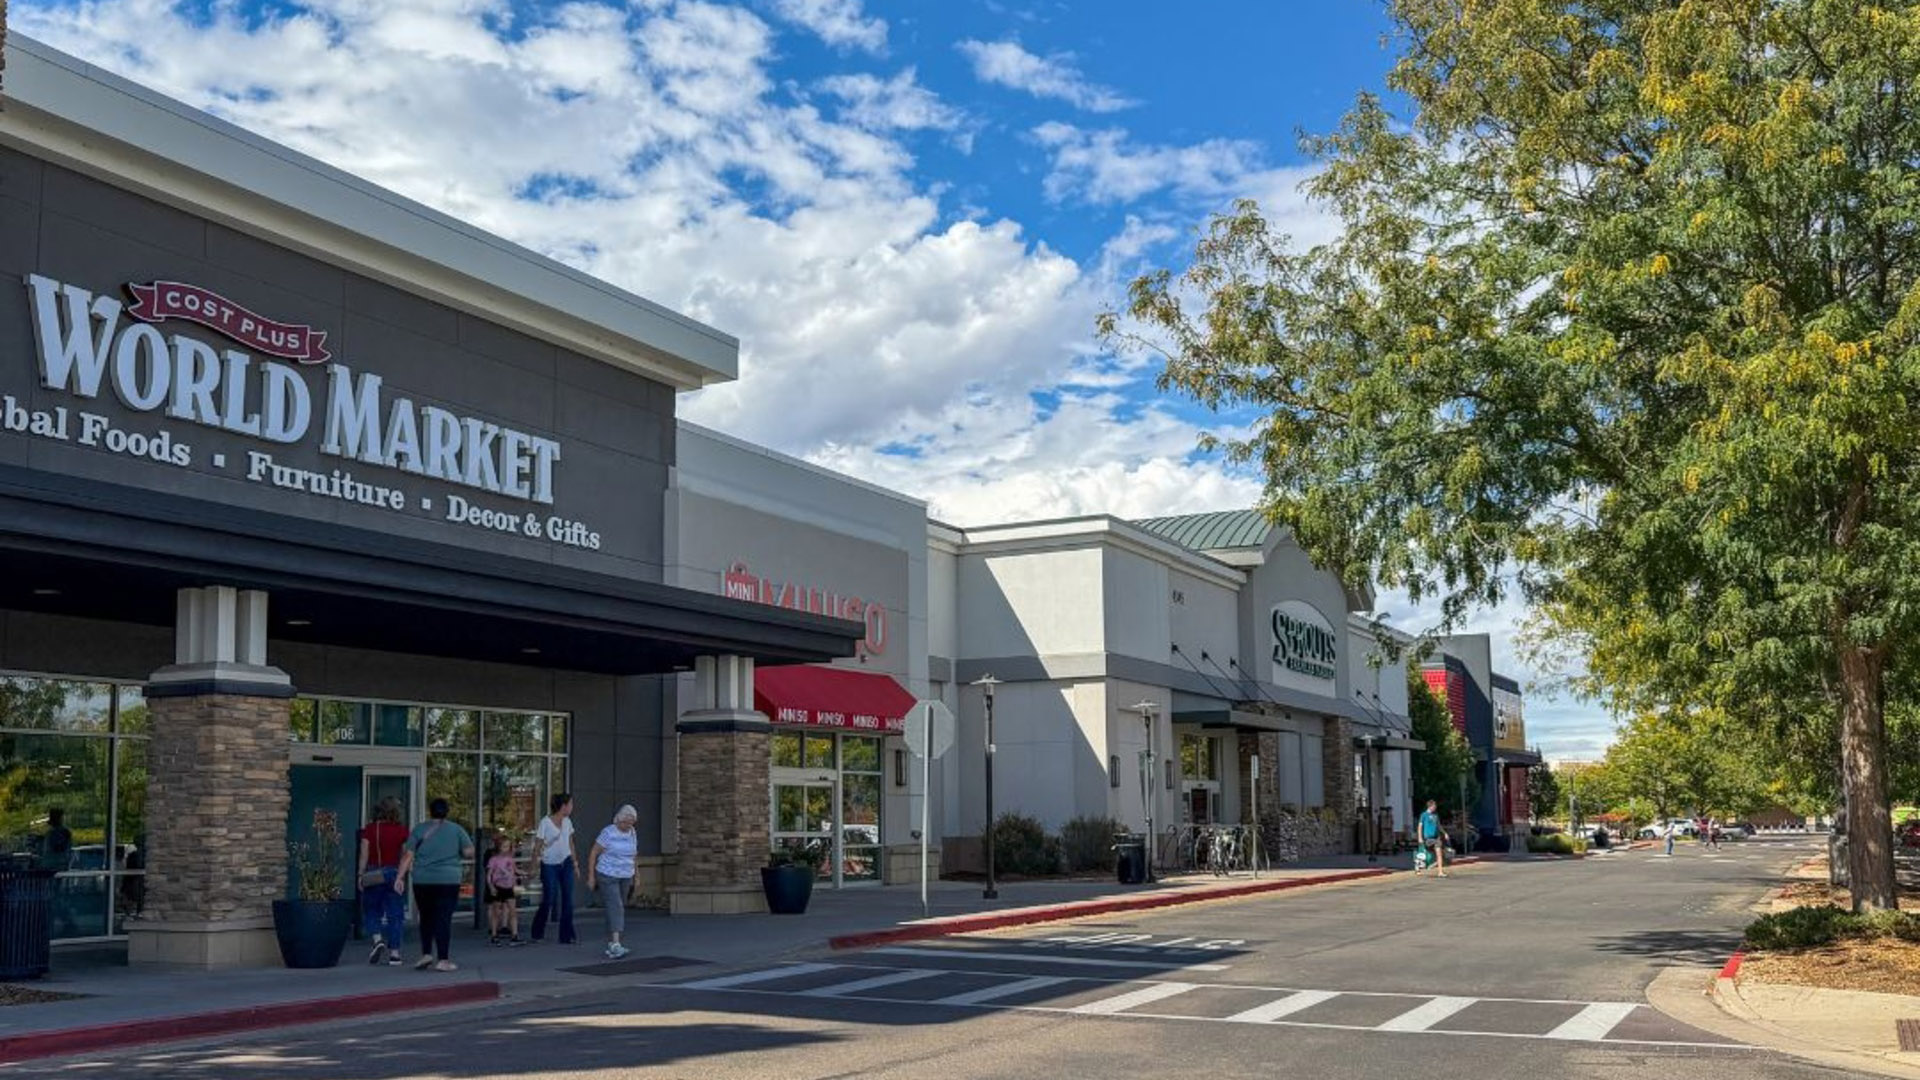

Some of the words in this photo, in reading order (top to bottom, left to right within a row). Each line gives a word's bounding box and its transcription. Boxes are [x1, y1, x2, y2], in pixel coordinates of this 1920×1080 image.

[166, 291, 234, 325] COST
[241, 319, 300, 349] PLUS
[25, 273, 311, 443] WORLD
[321, 364, 560, 504] MARKET
[0, 395, 69, 440] bal
[78, 412, 191, 467] Foods
[247, 451, 404, 510] Furniture
[446, 495, 519, 532] Decor
[524, 513, 542, 538] &
[547, 516, 600, 550] Gifts
[727, 580, 755, 601] MINI
[778, 707, 808, 723] MINISO
[817, 711, 845, 726] MINISO
[853, 715, 879, 729] MINISO
